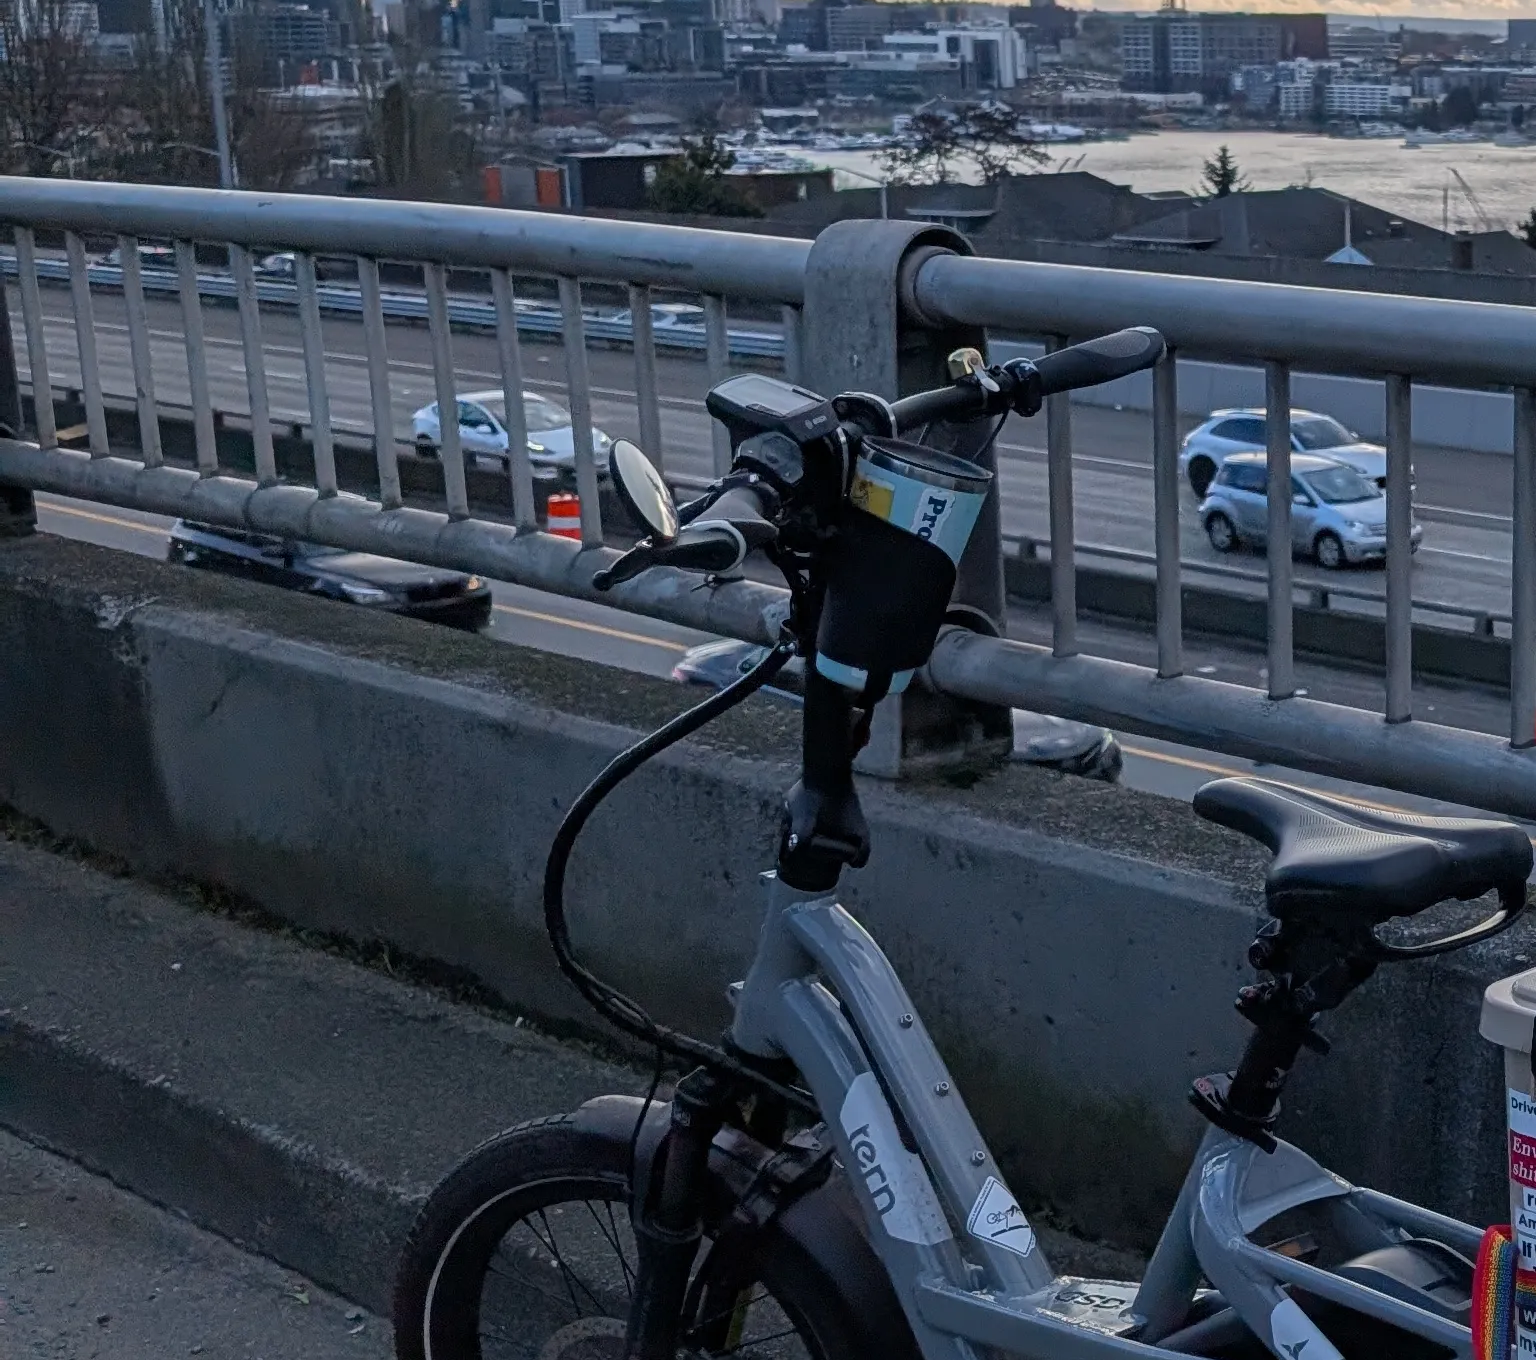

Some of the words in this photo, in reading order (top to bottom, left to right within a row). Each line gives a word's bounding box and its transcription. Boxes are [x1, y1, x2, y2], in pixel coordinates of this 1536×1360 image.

[918, 495, 947, 540] Pro
[849, 1123, 896, 1216] tern
[1522, 1241, 1532, 1257] If
